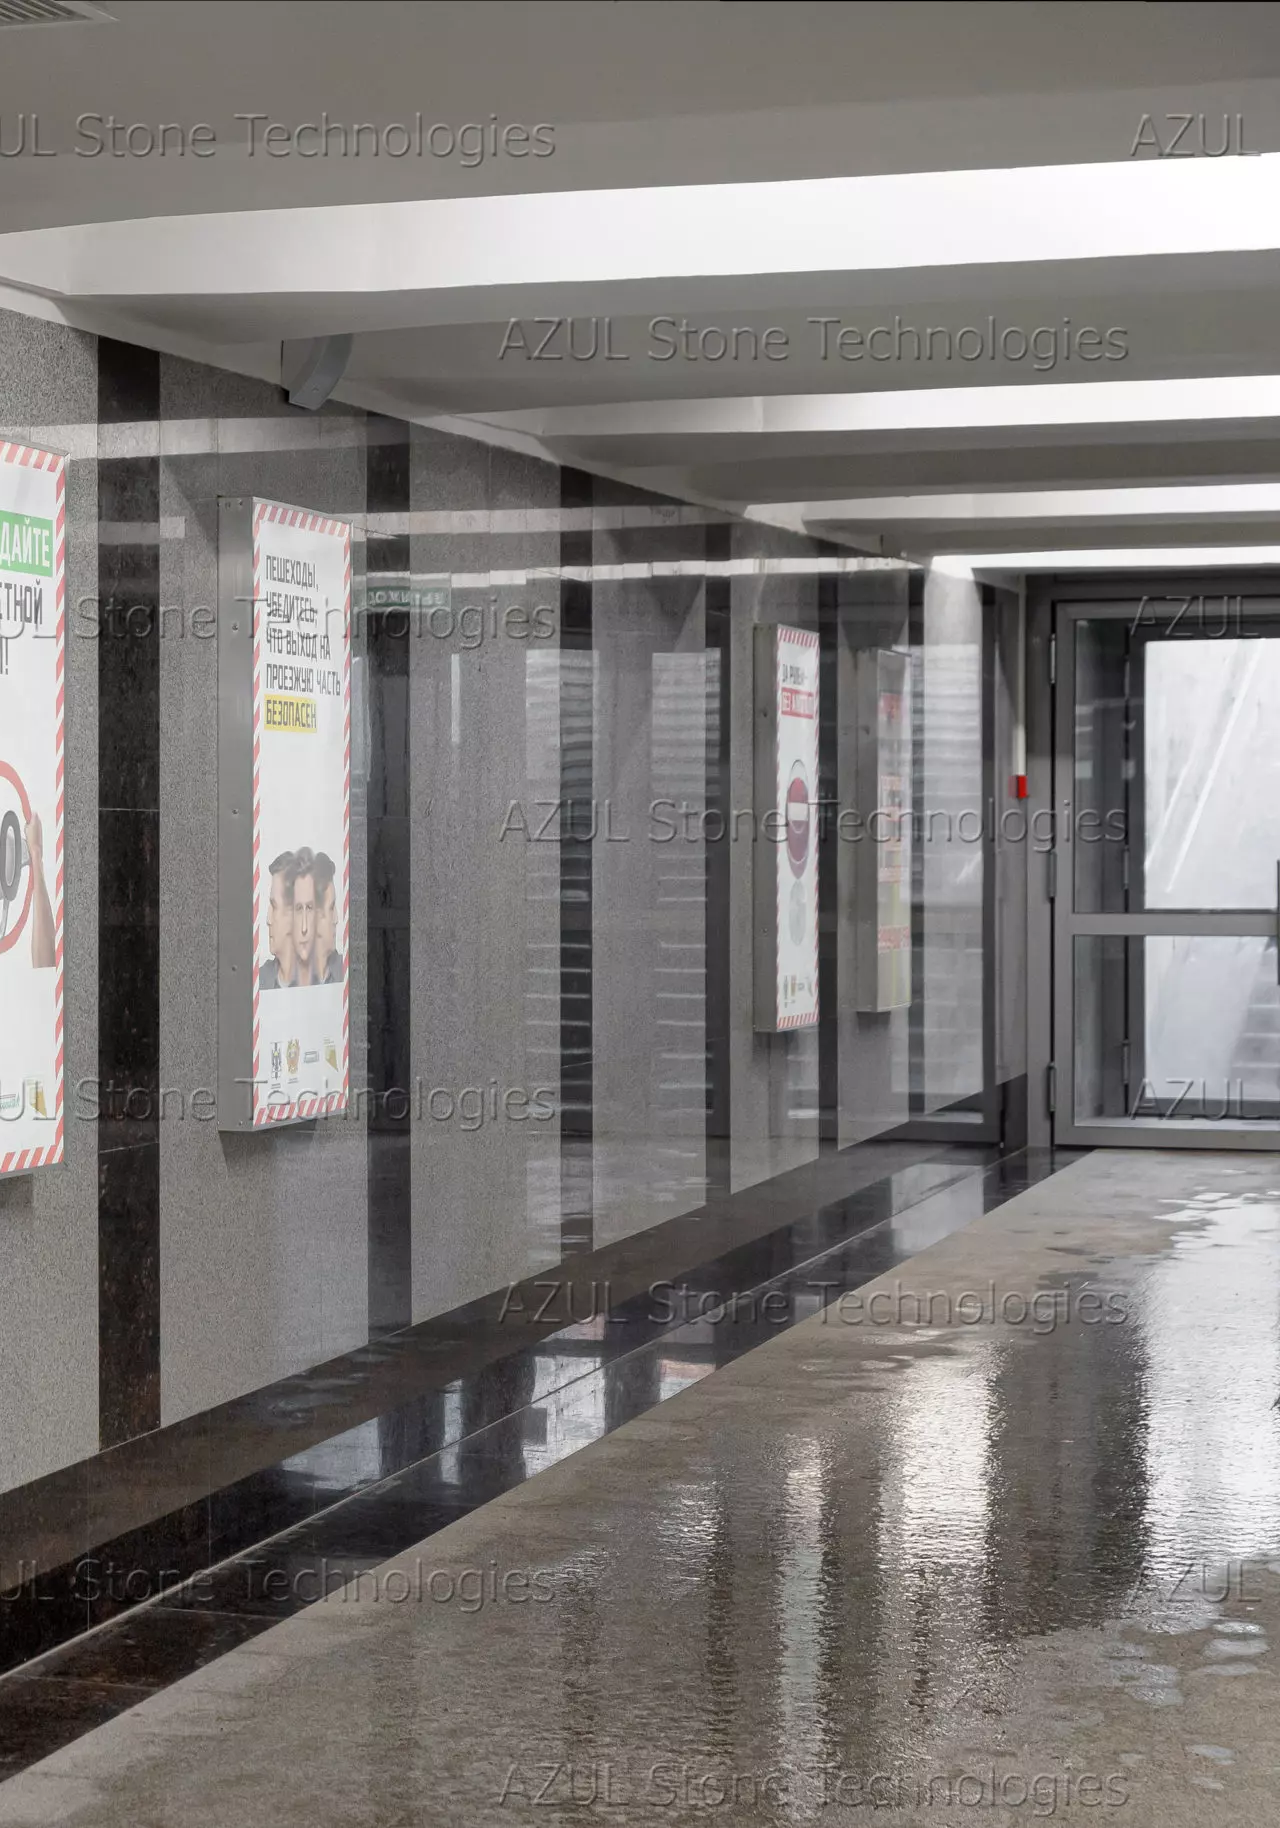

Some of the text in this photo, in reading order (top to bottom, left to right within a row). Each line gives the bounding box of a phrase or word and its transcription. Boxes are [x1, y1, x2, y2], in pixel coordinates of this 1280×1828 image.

[266, 555, 319, 592] ПЕШЕХОДЫ,
[266, 591, 318, 624] УБЕДИТЕСЬ,
[266, 627, 331, 662] ЧТО ВЫХОД НА
[266, 663, 341, 696] ПРОЕЗЖУЮ ЧАСТЬ
[266, 699, 317, 729] БЕЗОПАСЕН
